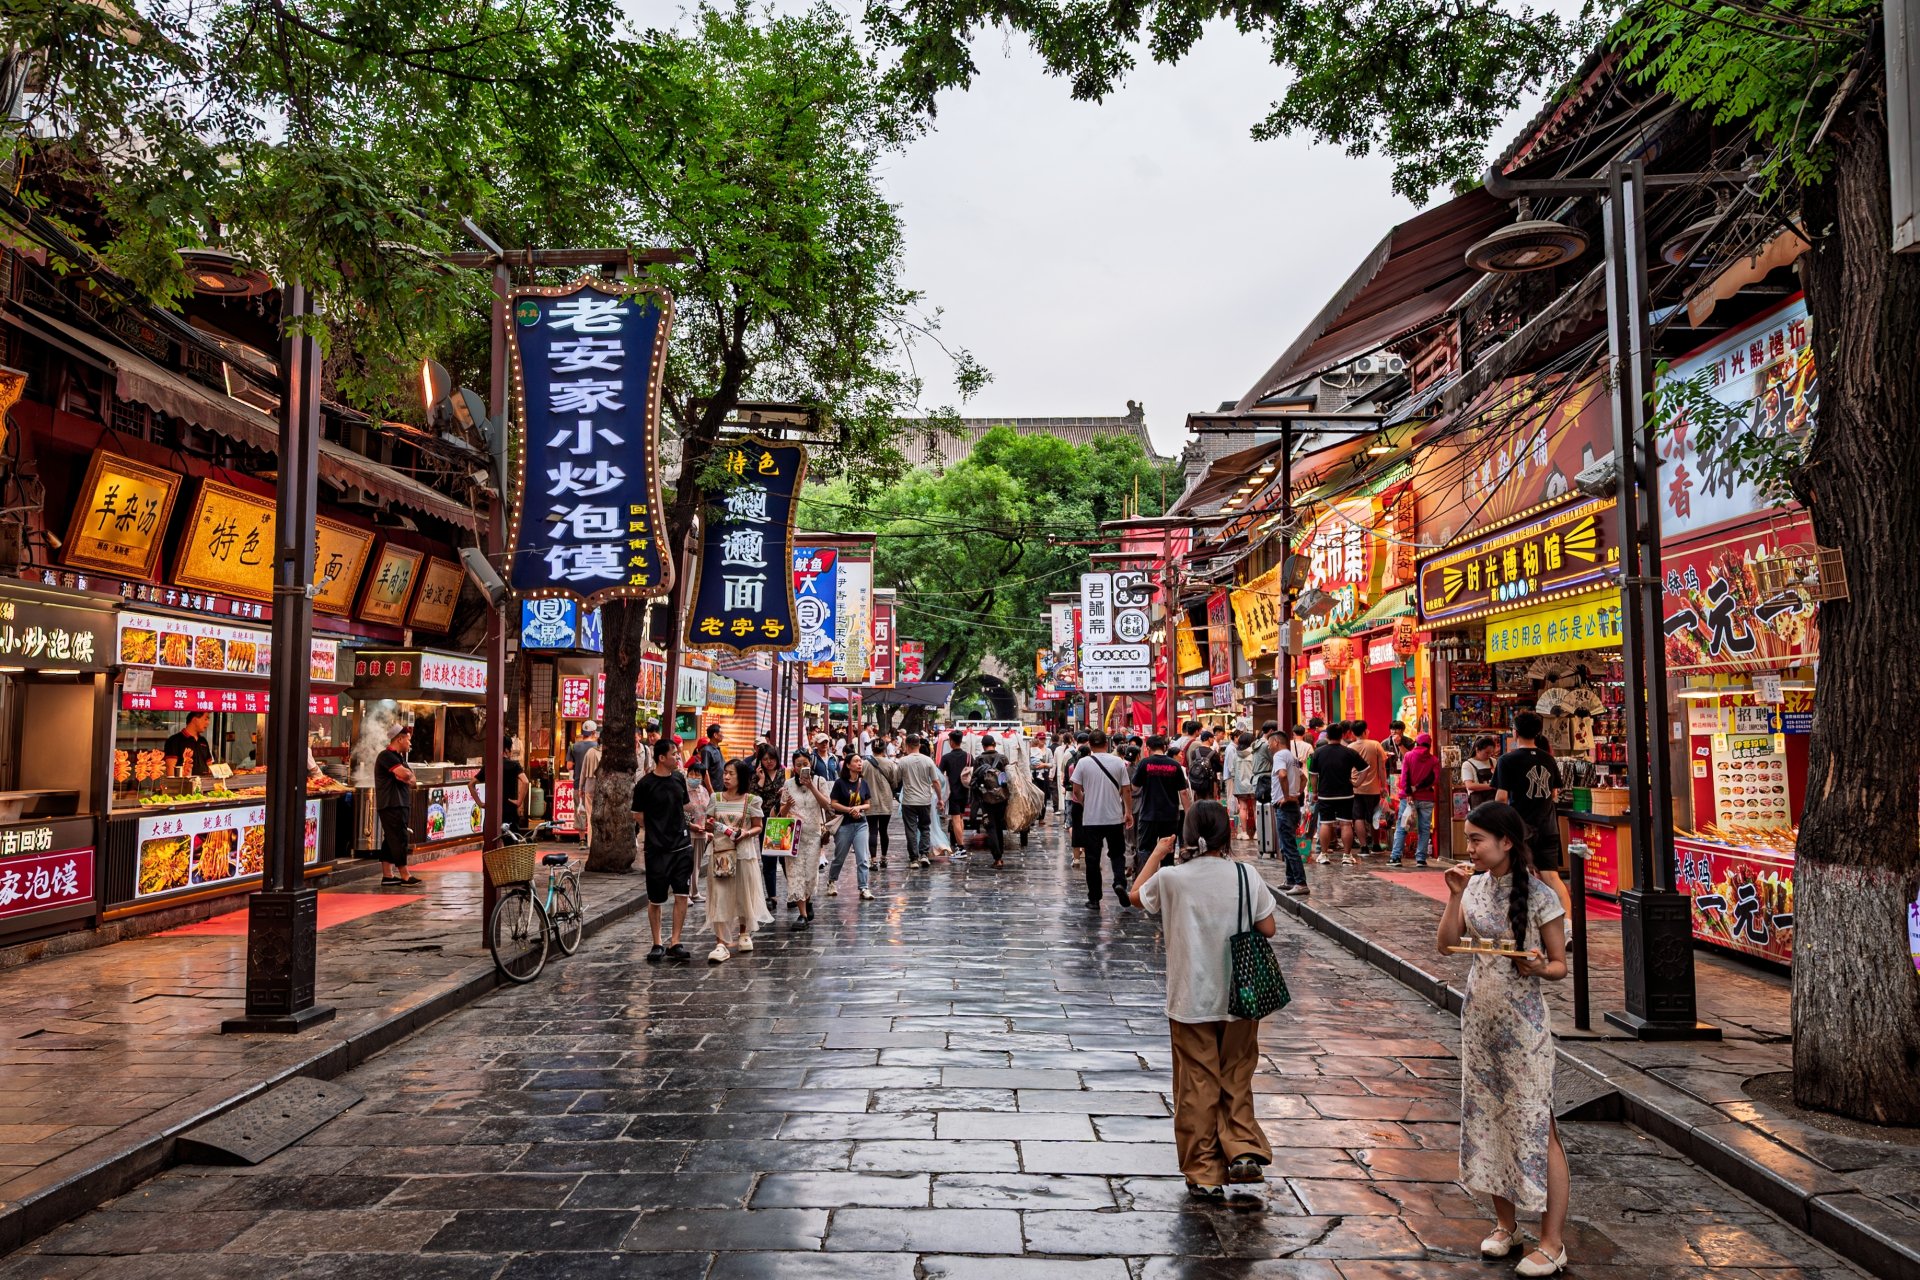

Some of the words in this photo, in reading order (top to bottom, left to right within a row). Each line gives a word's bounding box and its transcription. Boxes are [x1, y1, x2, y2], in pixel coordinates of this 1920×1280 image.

[544, 297, 629, 582] 老安家小炒泡馍
[725, 450, 780, 475] 特色
[95, 484, 157, 536] 羊杂汤
[628, 504, 649, 586] 回民街总店
[378, 562, 410, 595] 羊肉汤
[794, 557, 823, 572] 鱿鱼
[1467, 533, 1562, 592] 时光博物馆
[1662, 564, 1700, 597] 钵鸡
[700, 617, 785, 638] 老字号
[1663, 579, 1803, 656] 一元一
[0, 625, 95, 663] 小炒泡馍
[1737, 708, 1769, 721] 招聘
[1526, 765, 1550, 799] NY
[151, 818, 184, 836] 大鱿鱼
[0, 859, 79, 906] 家泡馍
